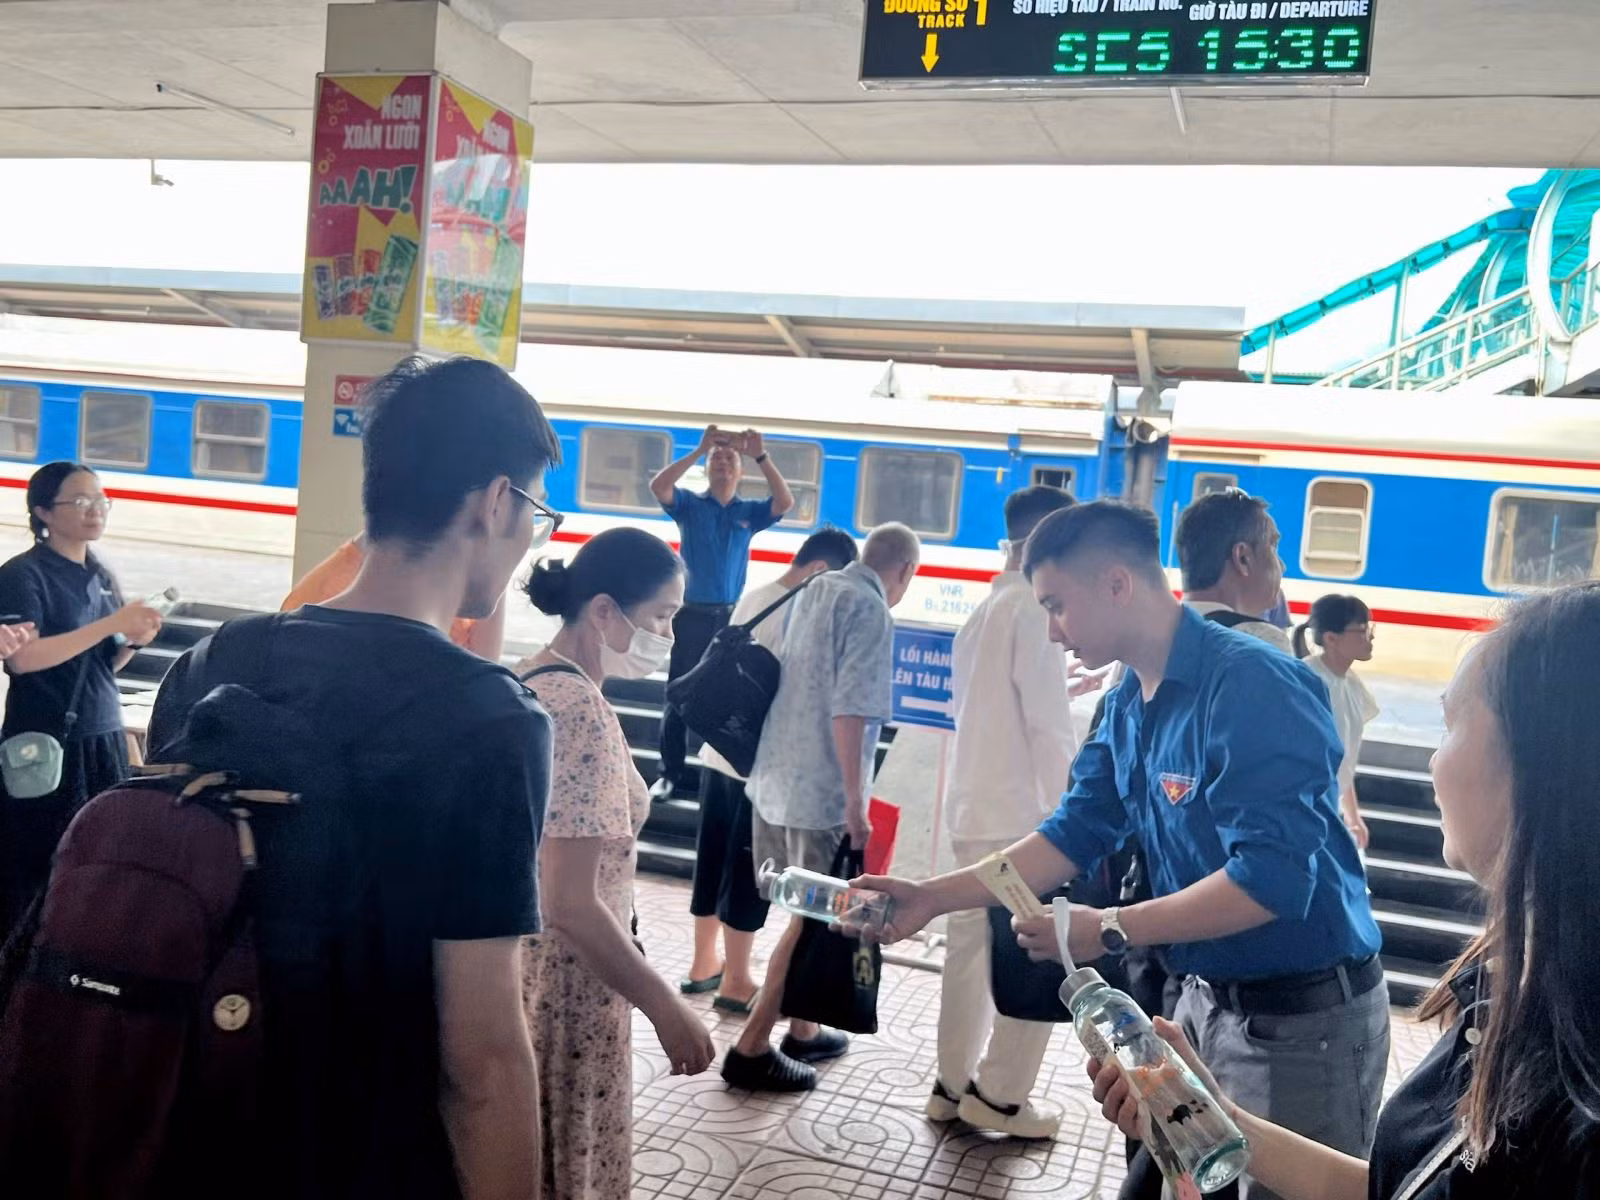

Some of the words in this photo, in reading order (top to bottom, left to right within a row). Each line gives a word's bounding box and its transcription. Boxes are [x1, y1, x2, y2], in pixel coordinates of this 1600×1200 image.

[974, 0, 988, 25] 1
[1113, 0, 1155, 12] TRAIN
[1189, 2, 1216, 20] GIỜ
[1218, 0, 1248, 20] TÀU
[1250, 3, 1267, 19] ĐI
[1268, 3, 1278, 19] /
[1280, 0, 1368, 18] DEPARTURE
[918, 14, 965, 28] TRACK
[1198, 28, 1360, 70] 15:30
[381, 95, 423, 120] NGON
[319, 165, 418, 214] AAAH!
[940, 584, 963, 597] VNR
[899, 644, 921, 664] LỐI
[923, 649, 952, 667] HÀN
[916, 671, 941, 689] TÀU
